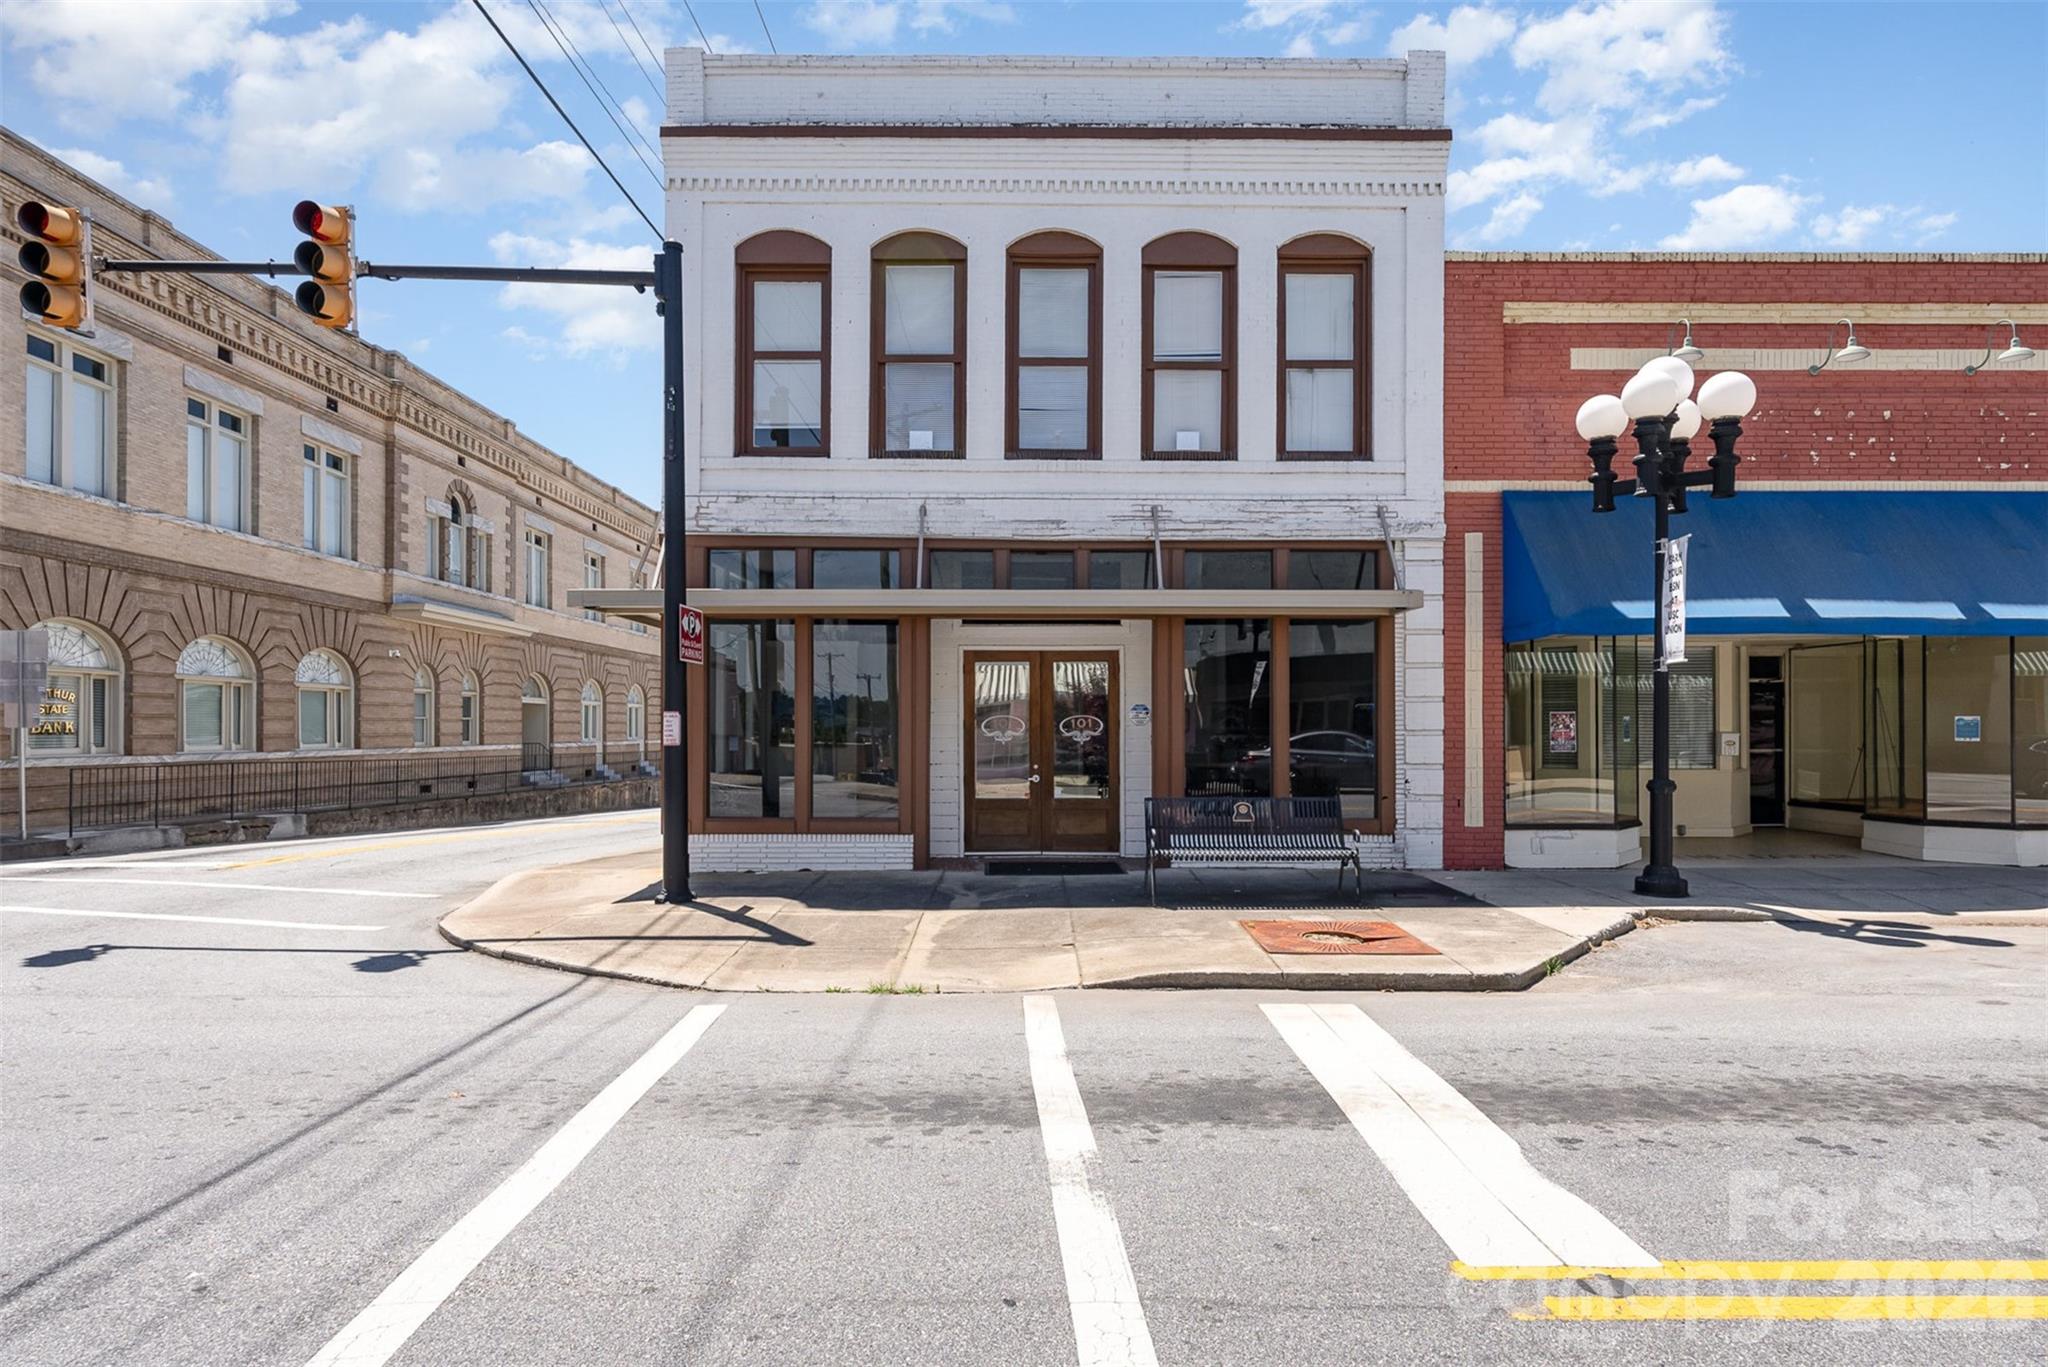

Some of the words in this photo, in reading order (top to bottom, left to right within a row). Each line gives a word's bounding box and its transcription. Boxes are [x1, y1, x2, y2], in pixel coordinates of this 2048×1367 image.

[681, 647, 701, 660] PARKING
[46, 688, 76, 703] THUR
[39, 704, 69, 714] STATE
[1071, 718, 1093, 729] 101
